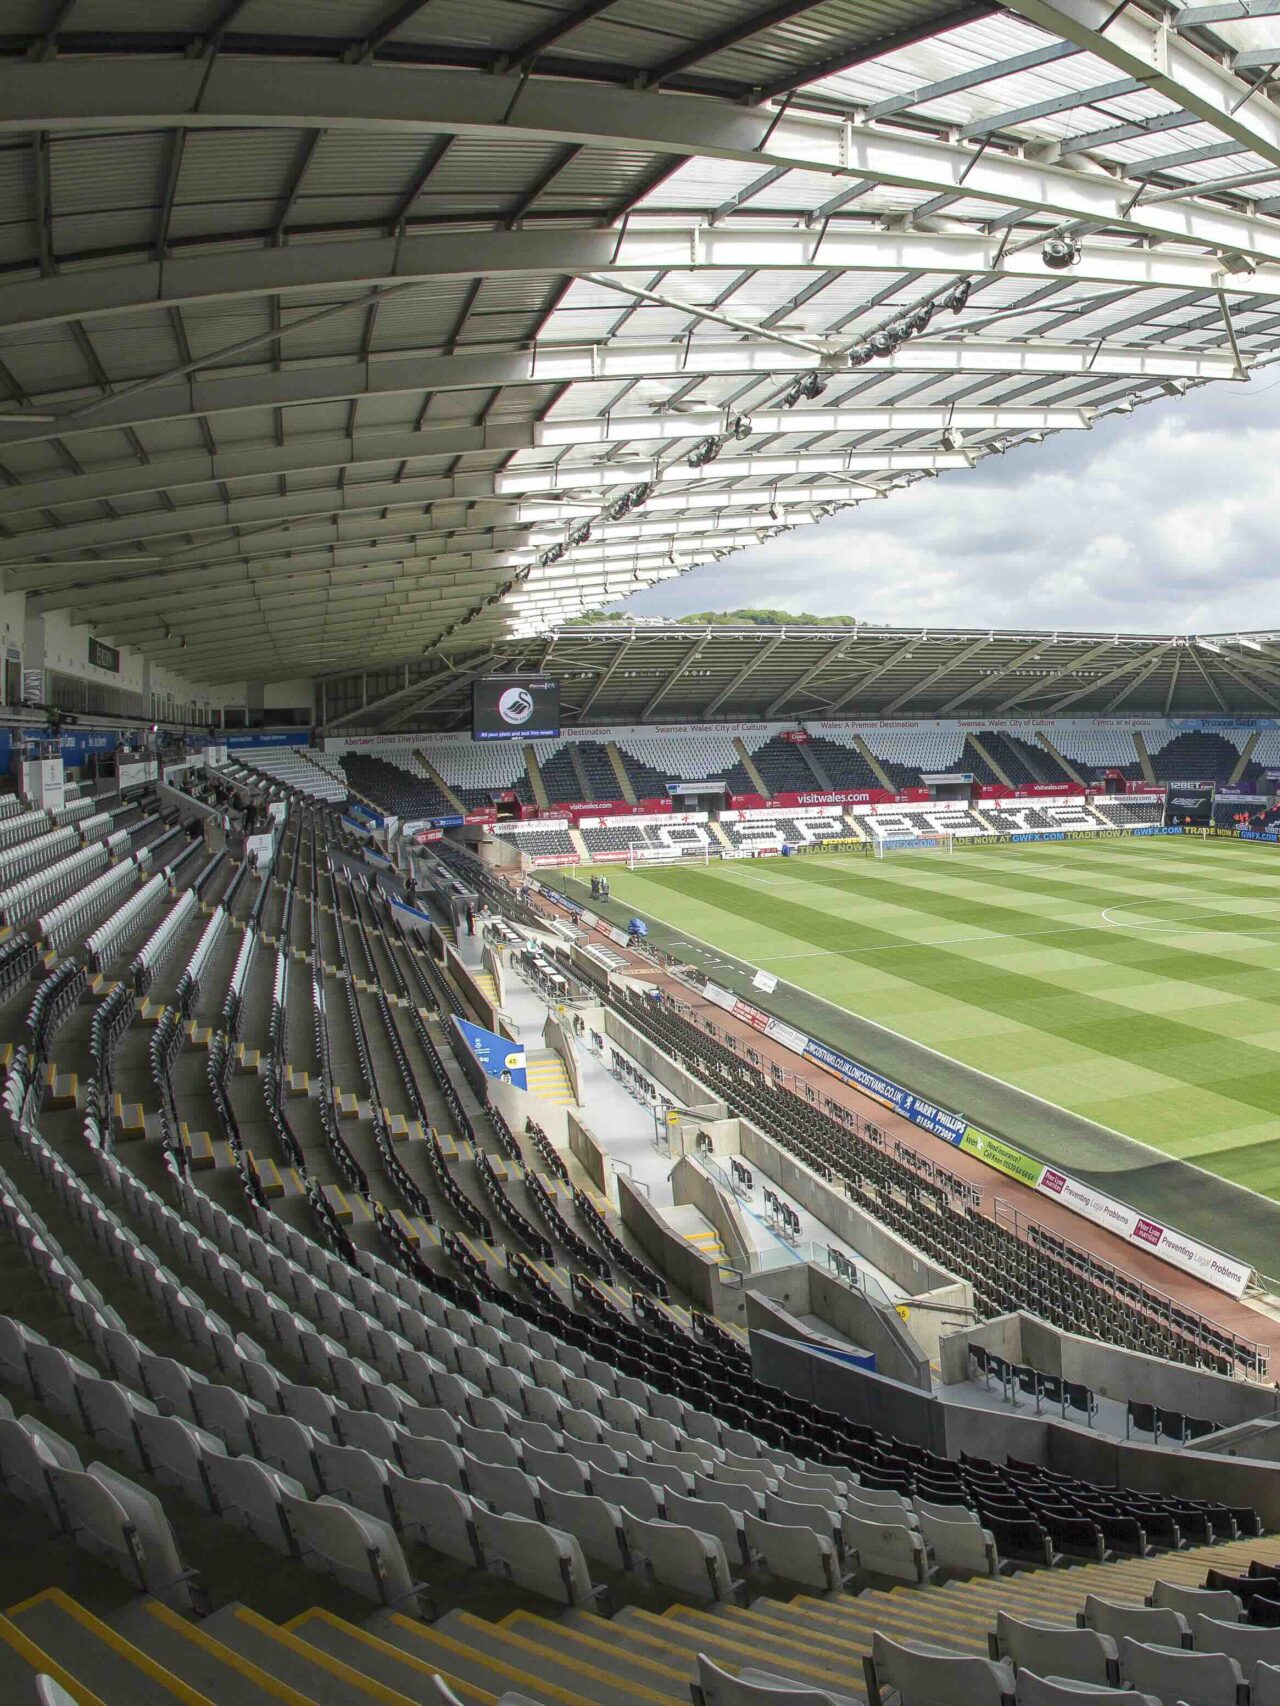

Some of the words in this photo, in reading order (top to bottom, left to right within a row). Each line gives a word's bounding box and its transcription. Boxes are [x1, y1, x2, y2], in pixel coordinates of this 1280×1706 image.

[715, 724, 731, 733] City
[732, 724, 740, 732] of
[741, 723, 768, 732] Culture
[880, 720, 919, 728] Destination
[1010, 720, 1024, 728] City
[1032, 719, 1055, 727] Culture
[1092, 719, 1114, 728] Cymru
[1132, 720, 1152, 728] gorau
[435, 734, 459, 744] Cymru
[567, 728, 611, 737] Destination
[798, 792, 870, 804] visitwales.com
[570, 802, 612, 810] visitwales.com
[800, 844, 835, 855] TRADE
[838, 844, 864, 852] NOW
[972, 836, 997, 845] NOW
[999, 834, 1012, 843] AT
[1012, 832, 1064, 842] GWFX.COM
[1066, 830, 1097, 840] TRADE
[1099, 829, 1120, 838] NOW
[1120, 829, 1132, 837] AT
[1134, 826, 1182, 836] GWFX.COM
[1184, 826, 1216, 835] TRADE
[1217, 828, 1232, 837] NOW
[1232, 830, 1241, 838] AT
[1241, 830, 1277, 842] GWFX.COM
[849, 1067, 903, 1103] LOWCOSTVANS.CO.UK
[914, 1100, 936, 1118] HARRY
[936, 1112, 966, 1134] PHILLIPS
[966, 1134, 978, 1148] keen
[984, 1150, 993, 1160] Call
[992, 1156, 1003, 1166] Keen
[987, 1140, 998, 1152] Need
[998, 1147, 1021, 1163] insurance?
[1045, 1172, 1055, 1181] Peter
[1054, 1176, 1064, 1186] Lynn
[1064, 1186, 1090, 1206] Preventing
[1090, 1199, 1104, 1211] Legal
[1103, 1206, 1129, 1225] Problems
[1138, 1221, 1148, 1232] Peter
[1148, 1226, 1160, 1238] Lynn
[1162, 1236, 1194, 1260] Preventing
[1194, 1254, 1210, 1267] Legal
[1210, 1261, 1242, 1283] Problems
